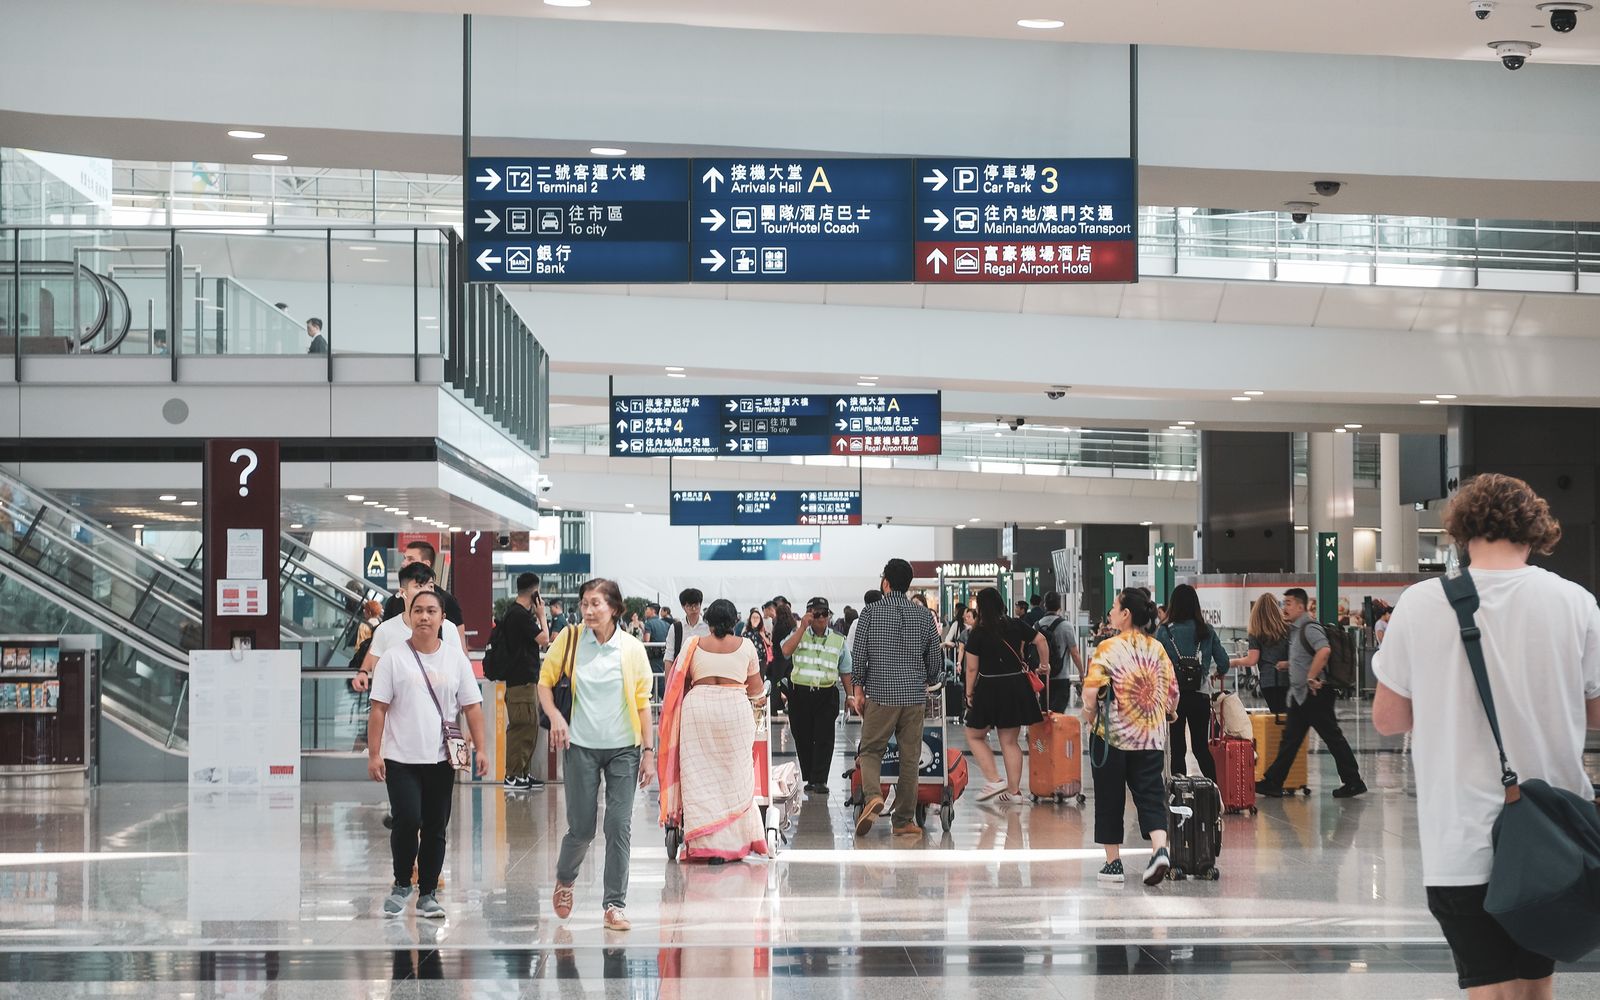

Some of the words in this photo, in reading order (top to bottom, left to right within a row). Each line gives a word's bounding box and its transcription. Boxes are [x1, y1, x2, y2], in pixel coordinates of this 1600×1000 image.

[508, 171, 530, 187] T2
[536, 164, 646, 181] 二號客運大樓
[731, 164, 803, 180] 接機大堂
[807, 166, 833, 193] A
[958, 169, 975, 190] P
[983, 164, 1037, 181] 停車場
[536, 181, 587, 193] Terminal
[590, 181, 598, 193] 2
[730, 181, 776, 194] Arrivals
[779, 181, 802, 193] Hall
[983, 182, 1003, 194] Car
[1006, 182, 1032, 194] Park
[1041, 167, 1059, 194] 3
[568, 205, 623, 222] 往市區
[760, 203, 871, 221] 團隊/酒店巴士
[568, 223, 583, 235] To
[586, 223, 607, 237] city
[760, 222, 821, 234] Tour/Hotel
[823, 222, 860, 234] Coach
[984, 222, 1077, 235] Mainland/Macao
[1078, 222, 1131, 237] Transport
[536, 244, 572, 262] 銀行
[983, 245, 1092, 262] 富豪機場酒店
[536, 261, 566, 274] Bank
[984, 262, 1016, 276] Regal
[1018, 262, 1059, 277] Airport
[1062, 262, 1092, 275] Hotel
[632, 401, 643, 411] T1
[741, 401, 752, 410] T2
[887, 397, 900, 412] A
[673, 419, 684, 433] 4
[778, 426, 790, 434] city
[367, 550, 385, 571] A
[1201, 609, 1222, 625] TCHEN
